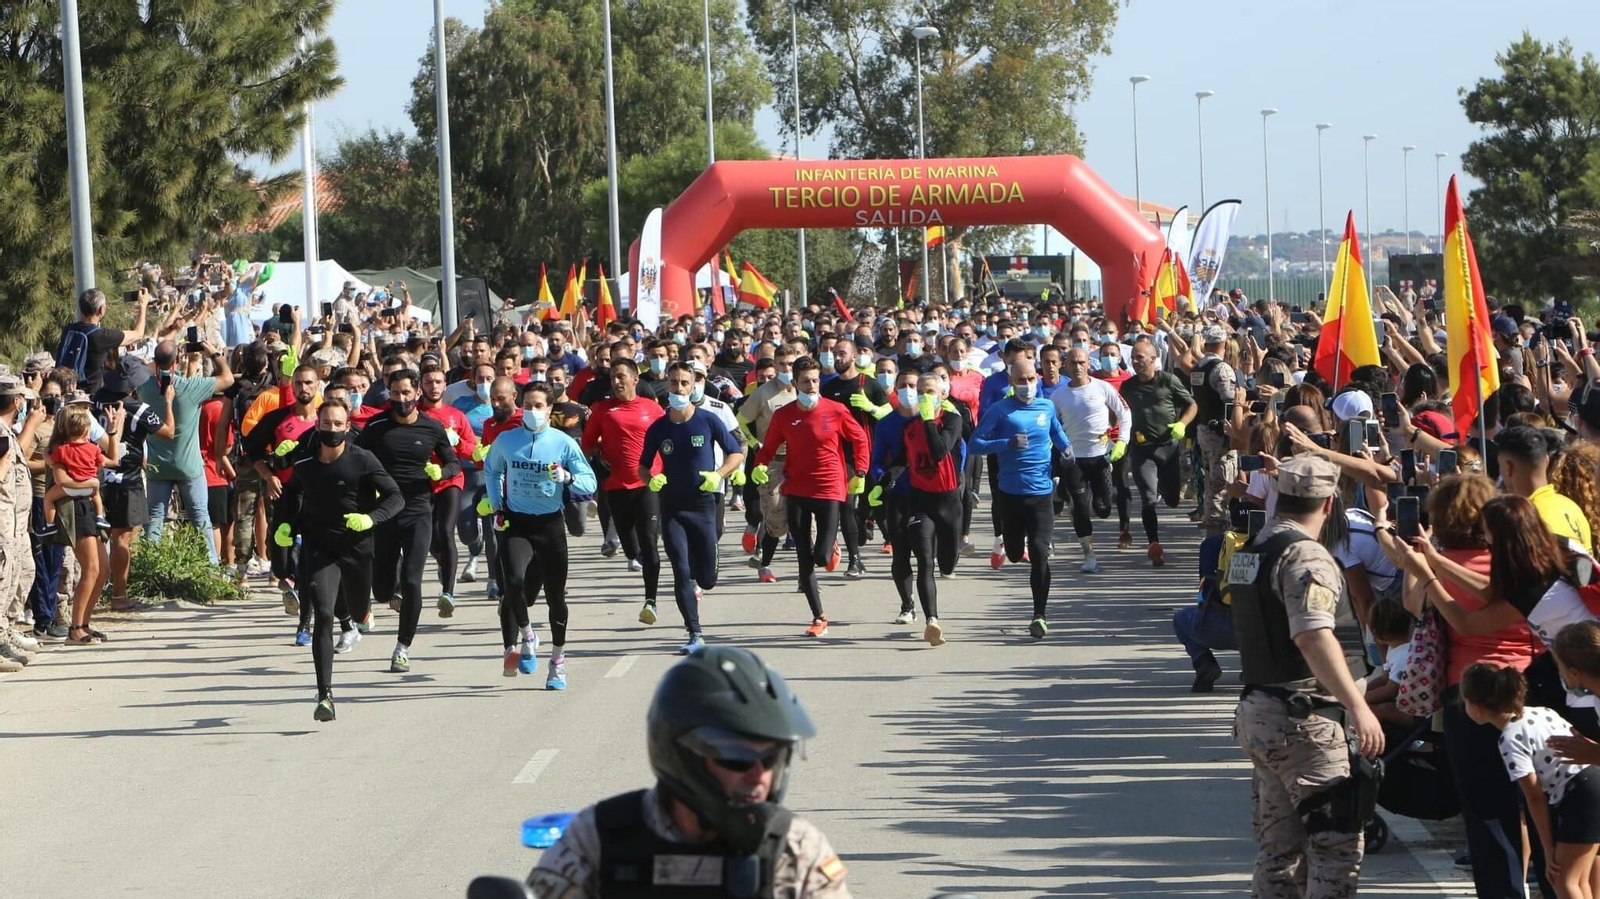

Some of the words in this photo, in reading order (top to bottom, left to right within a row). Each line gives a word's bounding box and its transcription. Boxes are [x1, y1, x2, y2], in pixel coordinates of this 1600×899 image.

[796, 165, 896, 181] INFANTERÍA
[901, 167, 922, 179] DE
[928, 165, 998, 178] MARINA
[769, 186, 860, 208] TERCIO
[869, 185, 901, 207] DE
[910, 182, 1025, 206] ARMADA
[855, 209, 943, 225] SALIDA
[512, 460, 549, 473] nerja
